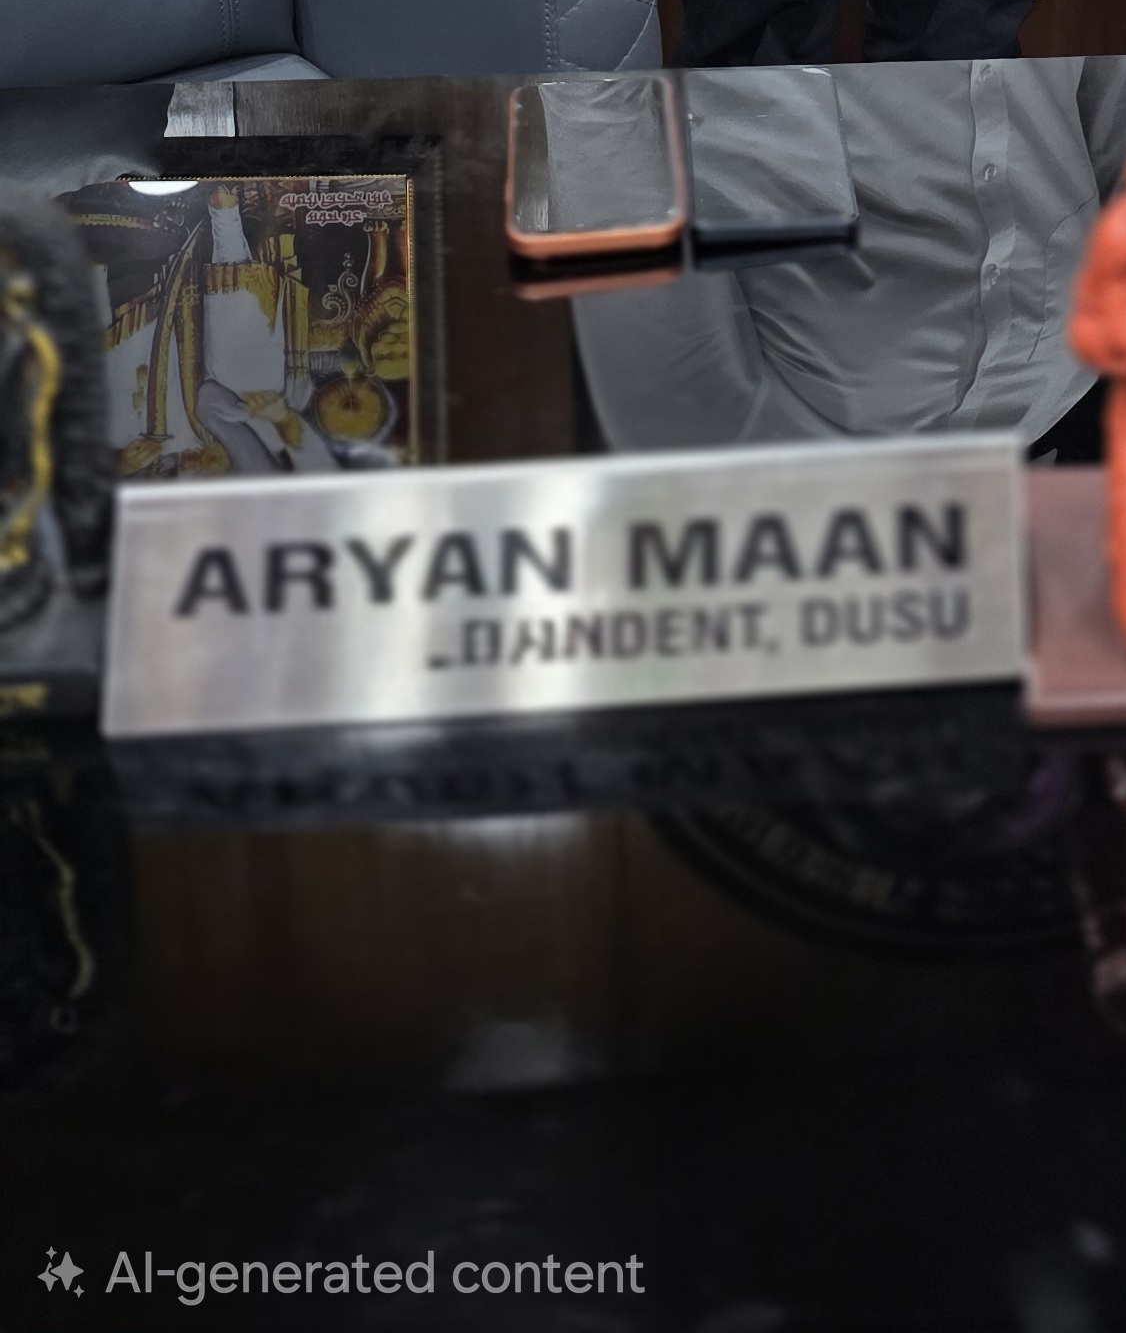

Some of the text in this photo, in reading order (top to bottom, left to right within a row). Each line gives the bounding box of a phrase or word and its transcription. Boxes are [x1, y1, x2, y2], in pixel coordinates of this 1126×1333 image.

[173, 502, 969, 617] ARYAN MAAN
[801, 589, 970, 647] DUSU
